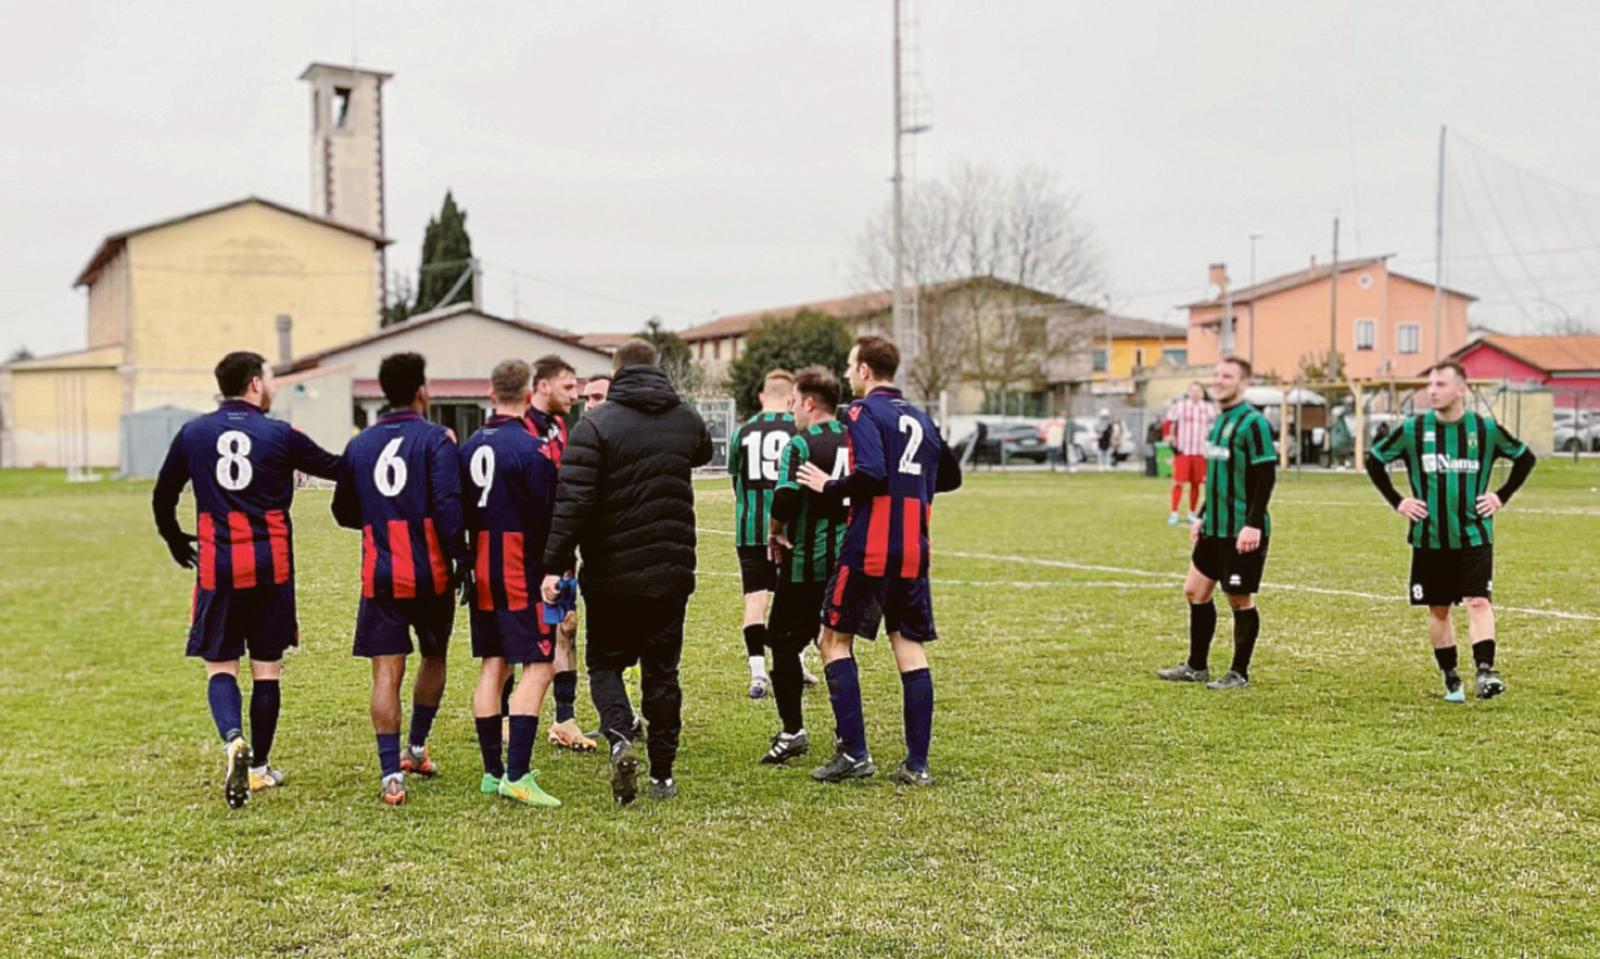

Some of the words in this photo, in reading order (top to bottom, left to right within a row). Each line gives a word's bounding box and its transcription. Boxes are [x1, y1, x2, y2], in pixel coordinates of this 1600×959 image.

[216, 430, 253, 491] 8
[374, 436, 407, 497] 6
[470, 445, 495, 507] 9
[742, 430, 791, 481] 19
[898, 415, 923, 476] 2
[1412, 583, 1424, 600] 8
